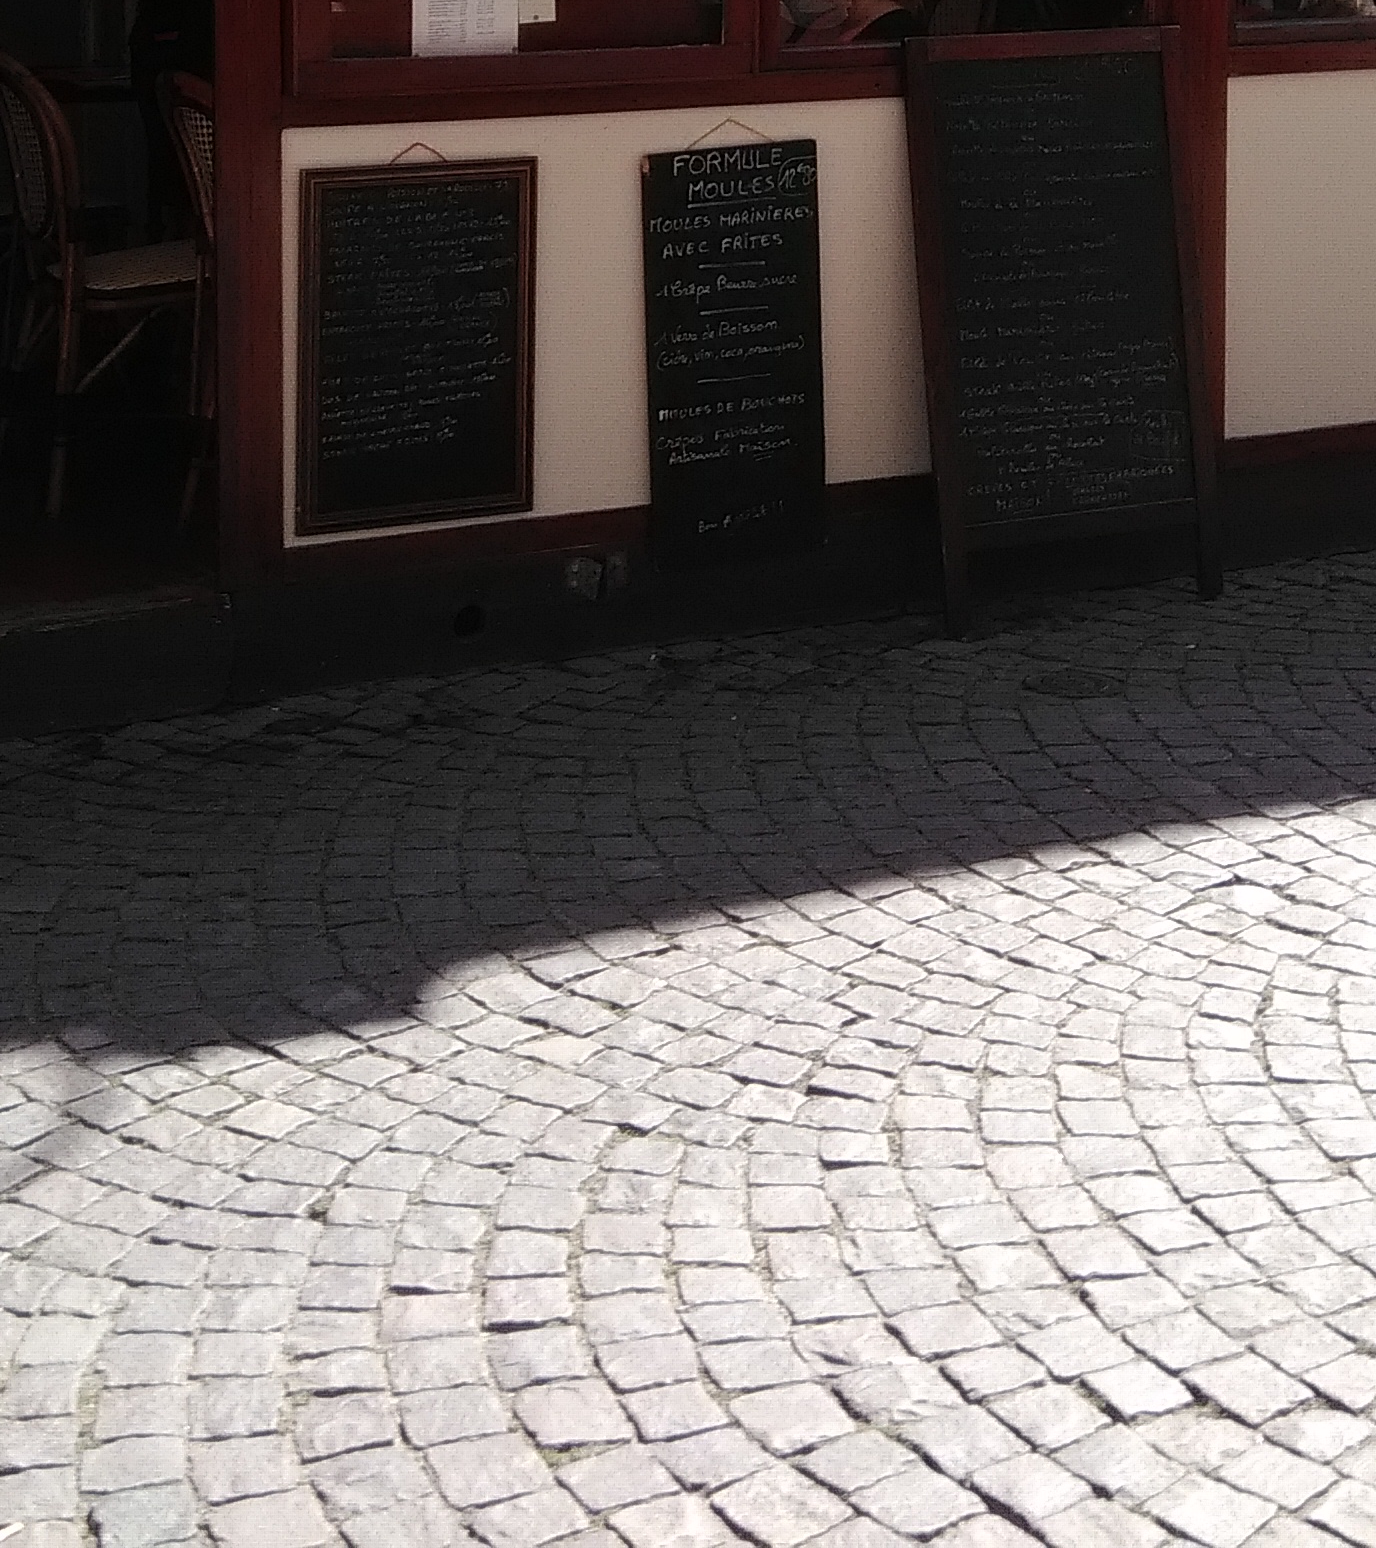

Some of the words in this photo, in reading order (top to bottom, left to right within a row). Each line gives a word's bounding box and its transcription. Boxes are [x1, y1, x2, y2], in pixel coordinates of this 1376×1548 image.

[673, 147, 784, 177] FORMULE
[688, 175, 776, 201] MOULES
[650, 215, 712, 234] MOULES
[662, 240, 711, 260] AVEC
[720, 232, 784, 254] FRITES
[716, 401, 735, 415] DE
